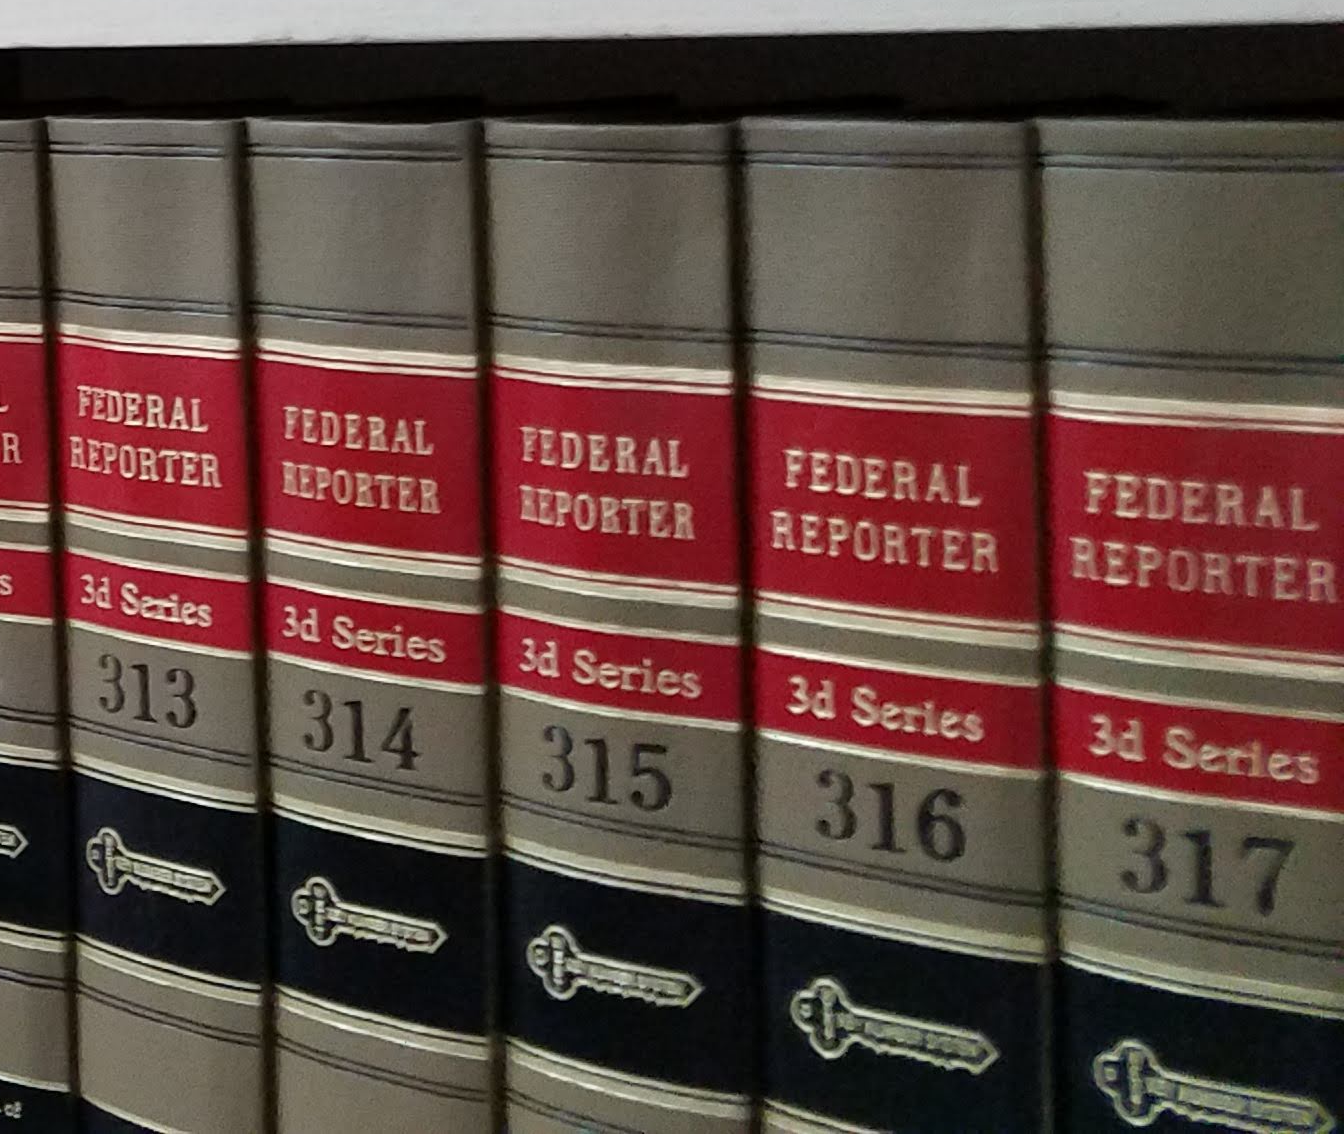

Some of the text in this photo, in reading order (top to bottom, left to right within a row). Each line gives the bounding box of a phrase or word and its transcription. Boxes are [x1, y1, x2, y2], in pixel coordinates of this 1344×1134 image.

[76, 384, 209, 433] FEDERAL
[282, 405, 434, 457] FEDERAL
[69, 435, 223, 490] REPORTER
[519, 425, 690, 479] FEDERAL
[783, 447, 984, 508] FEDERAL
[281, 460, 442, 515] REPORTER
[519, 484, 696, 542] REPORTER
[1084, 470, 1319, 533] FEDERAL
[770, 510, 1000, 574] REPORTER
[1069, 536, 1340, 604] REPORTER
[80, 574, 212, 629] 3d Series
[282, 606, 446, 665] 3d Series
[98, 653, 198, 730] 313
[519, 637, 702, 700] 3d Series
[300, 689, 420, 771] 314
[787, 674, 985, 743] 3d Series
[542, 725, 673, 814] 315
[1088, 714, 1321, 785] 3d Series
[815, 769, 967, 863] 316
[1120, 816, 1297, 917] 317
